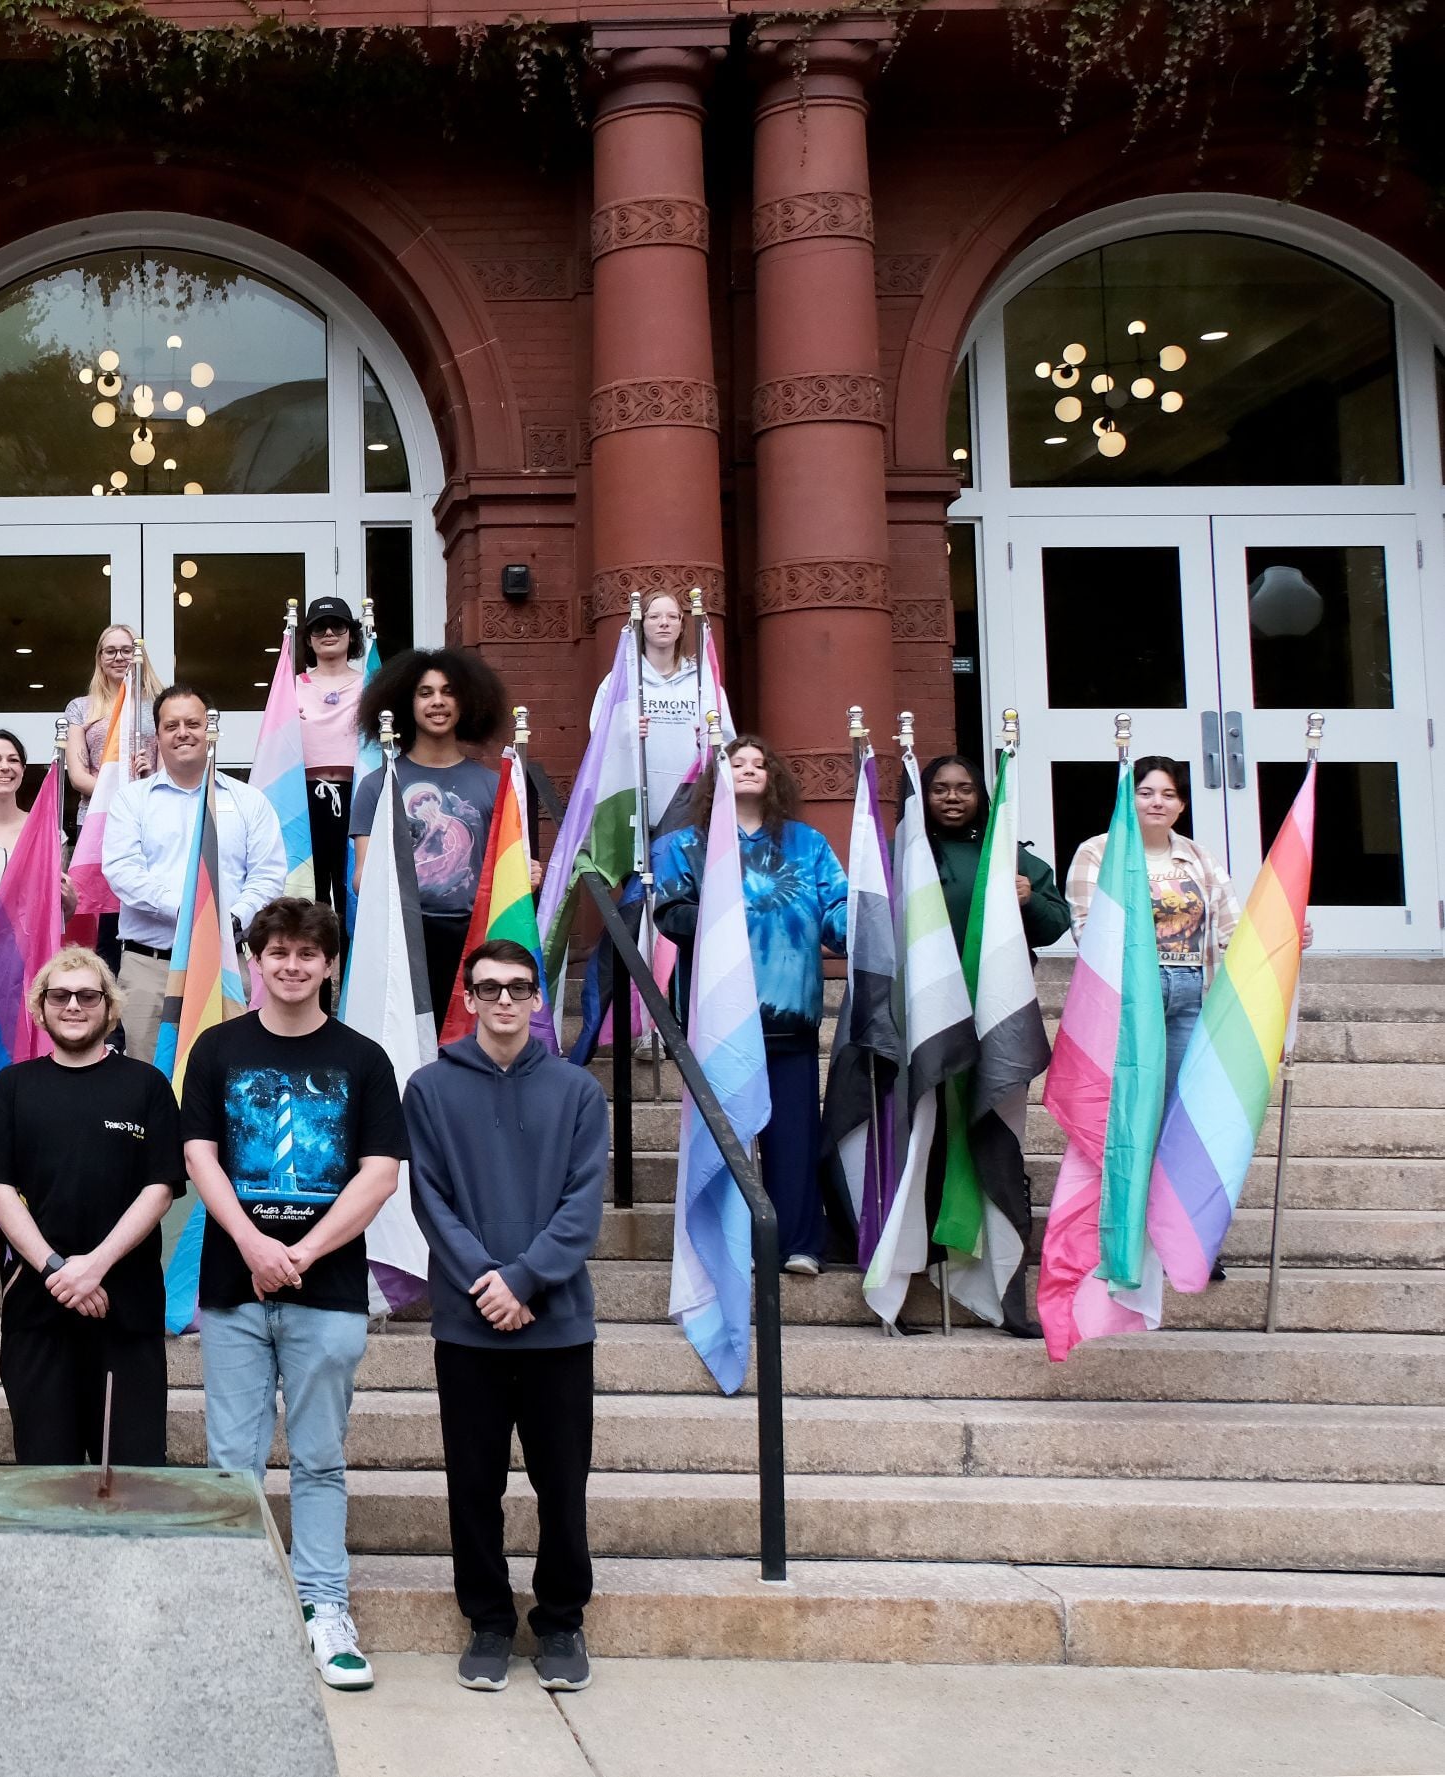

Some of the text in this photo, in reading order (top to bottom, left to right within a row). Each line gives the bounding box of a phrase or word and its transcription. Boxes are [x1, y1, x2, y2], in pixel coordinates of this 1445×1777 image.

[643, 699, 696, 709] ERMONT
[252, 1203, 315, 1215] Outer Banks
